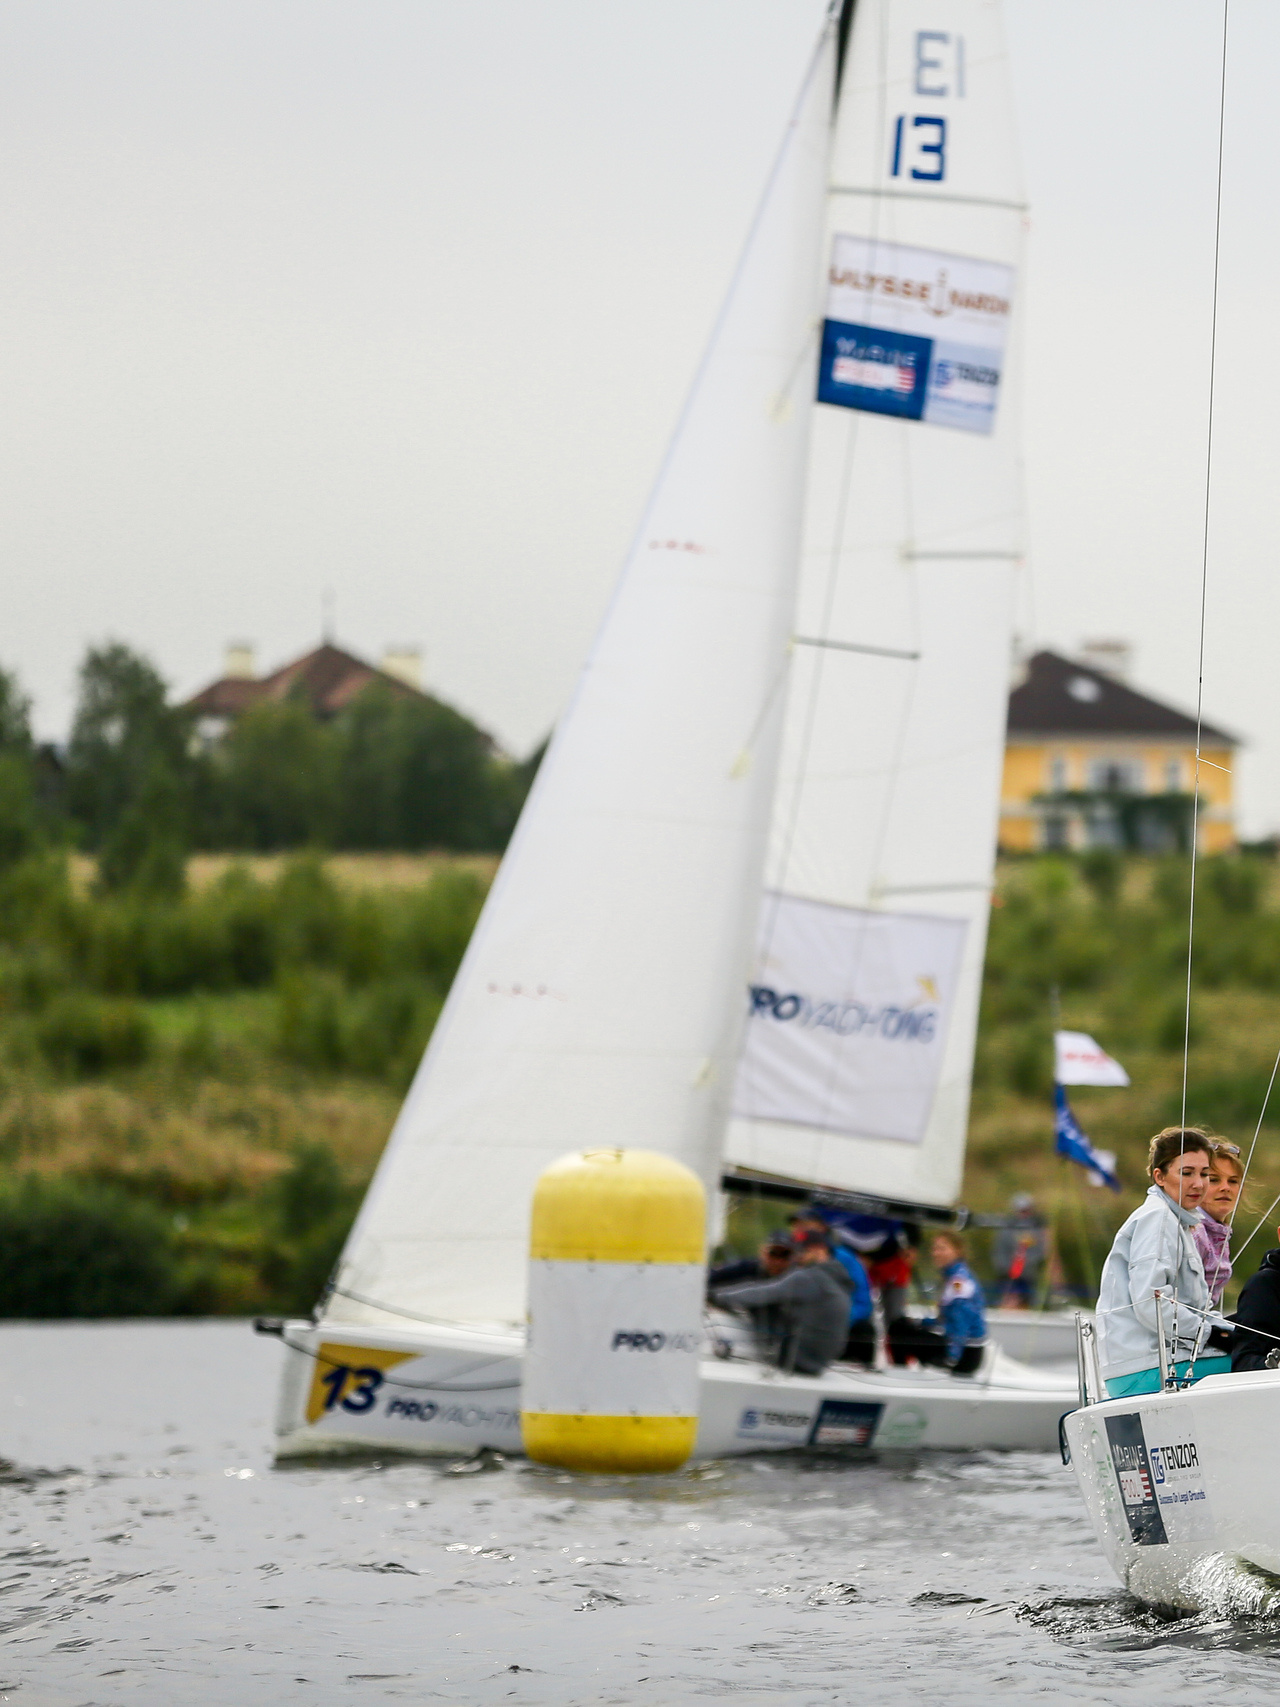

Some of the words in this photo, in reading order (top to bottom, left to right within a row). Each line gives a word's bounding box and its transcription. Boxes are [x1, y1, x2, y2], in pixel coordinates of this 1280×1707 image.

[891, 115, 946, 181] 13
[321, 1366, 385, 1414] 13
[1160, 1443, 1199, 1470] TENZOR
